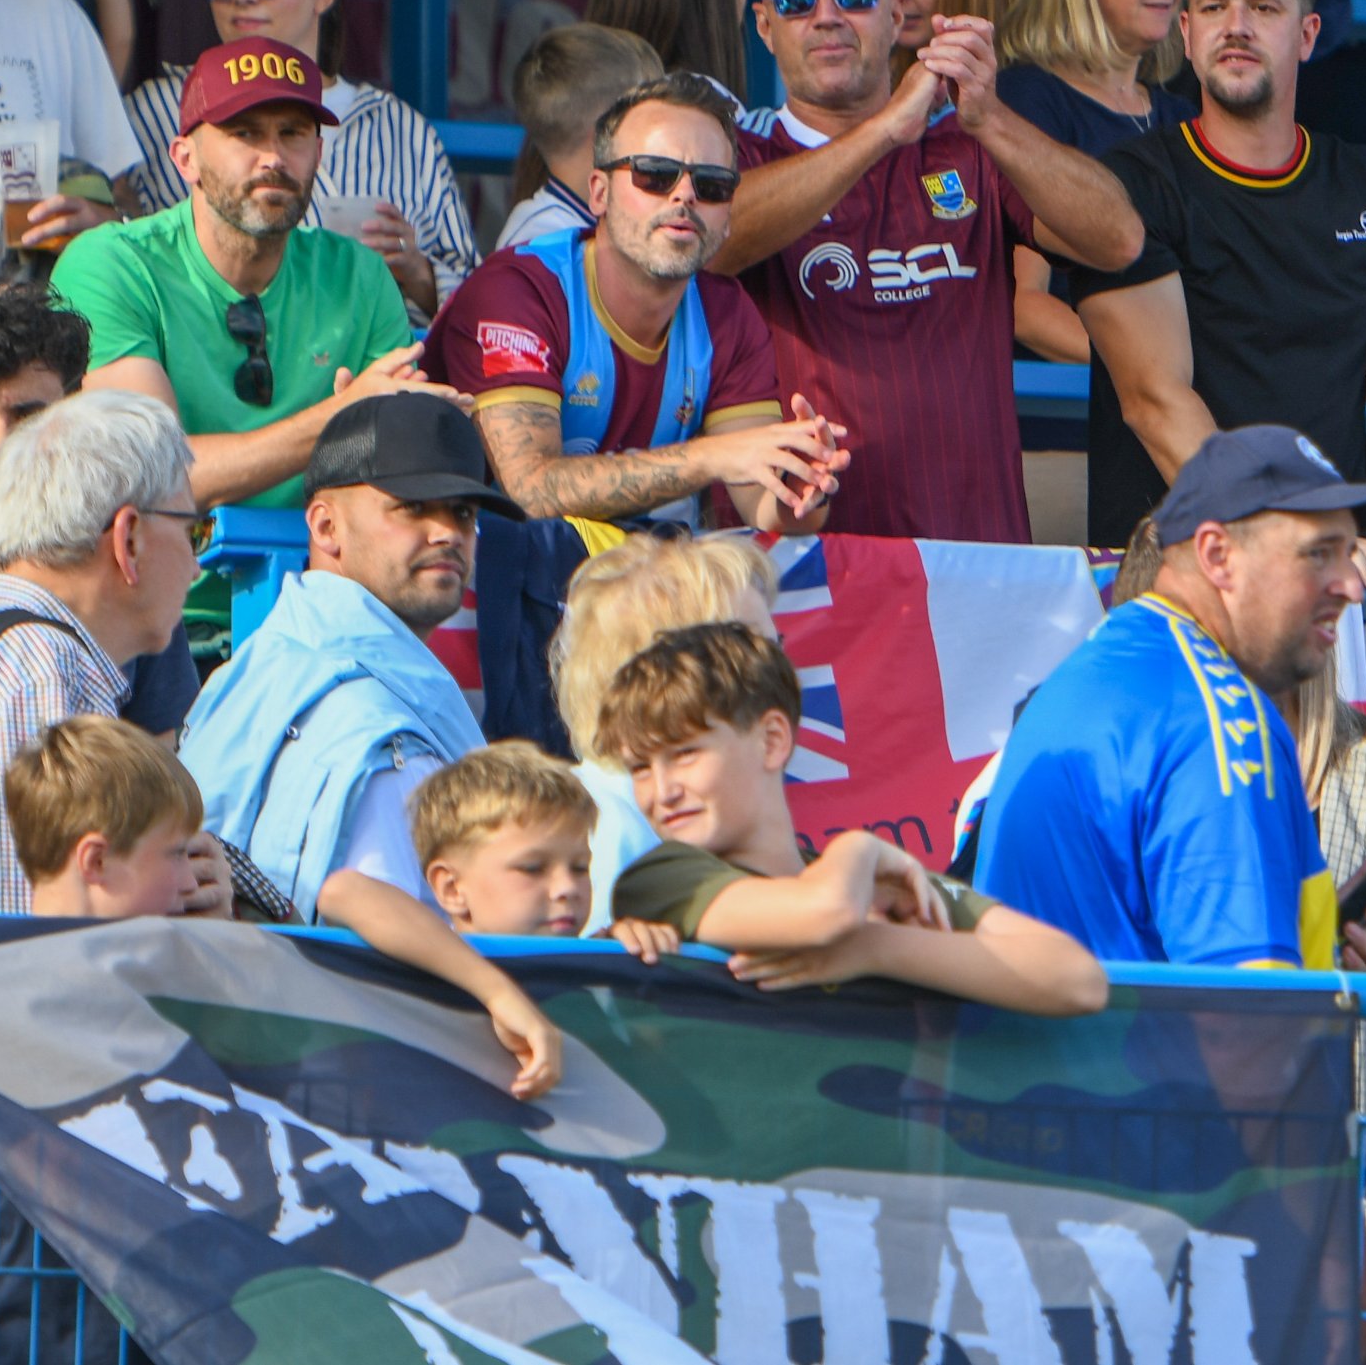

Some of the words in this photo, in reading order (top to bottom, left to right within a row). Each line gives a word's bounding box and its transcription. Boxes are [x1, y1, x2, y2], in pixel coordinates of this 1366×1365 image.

[223, 52, 306, 86] 1906
[867, 242, 977, 289] SCL
[874, 285, 931, 303] COLLEGE
[485, 327, 540, 355] PITCHING
